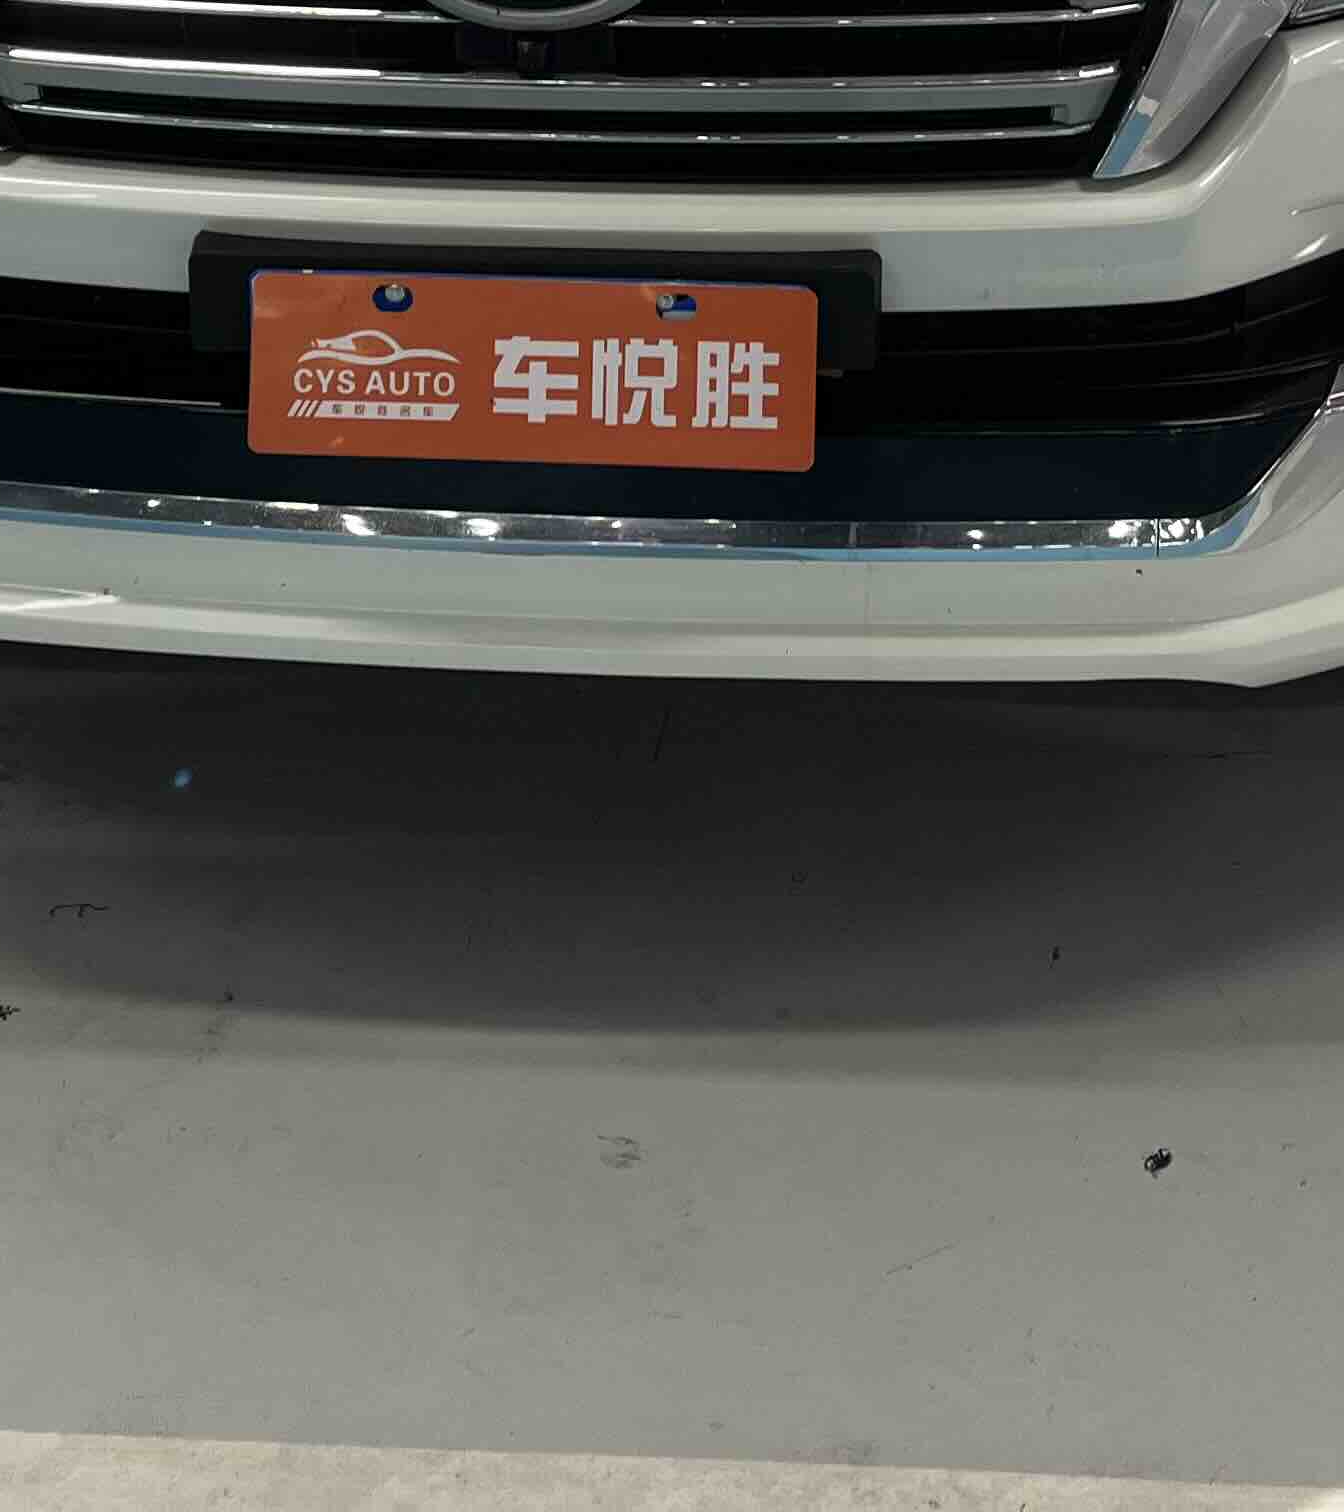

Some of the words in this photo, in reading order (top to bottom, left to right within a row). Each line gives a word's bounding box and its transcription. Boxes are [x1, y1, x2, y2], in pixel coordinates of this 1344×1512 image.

[293, 368, 356, 396] CYS
[364, 370, 456, 397] AUTO
[492, 335, 781, 430] 车悦胜
